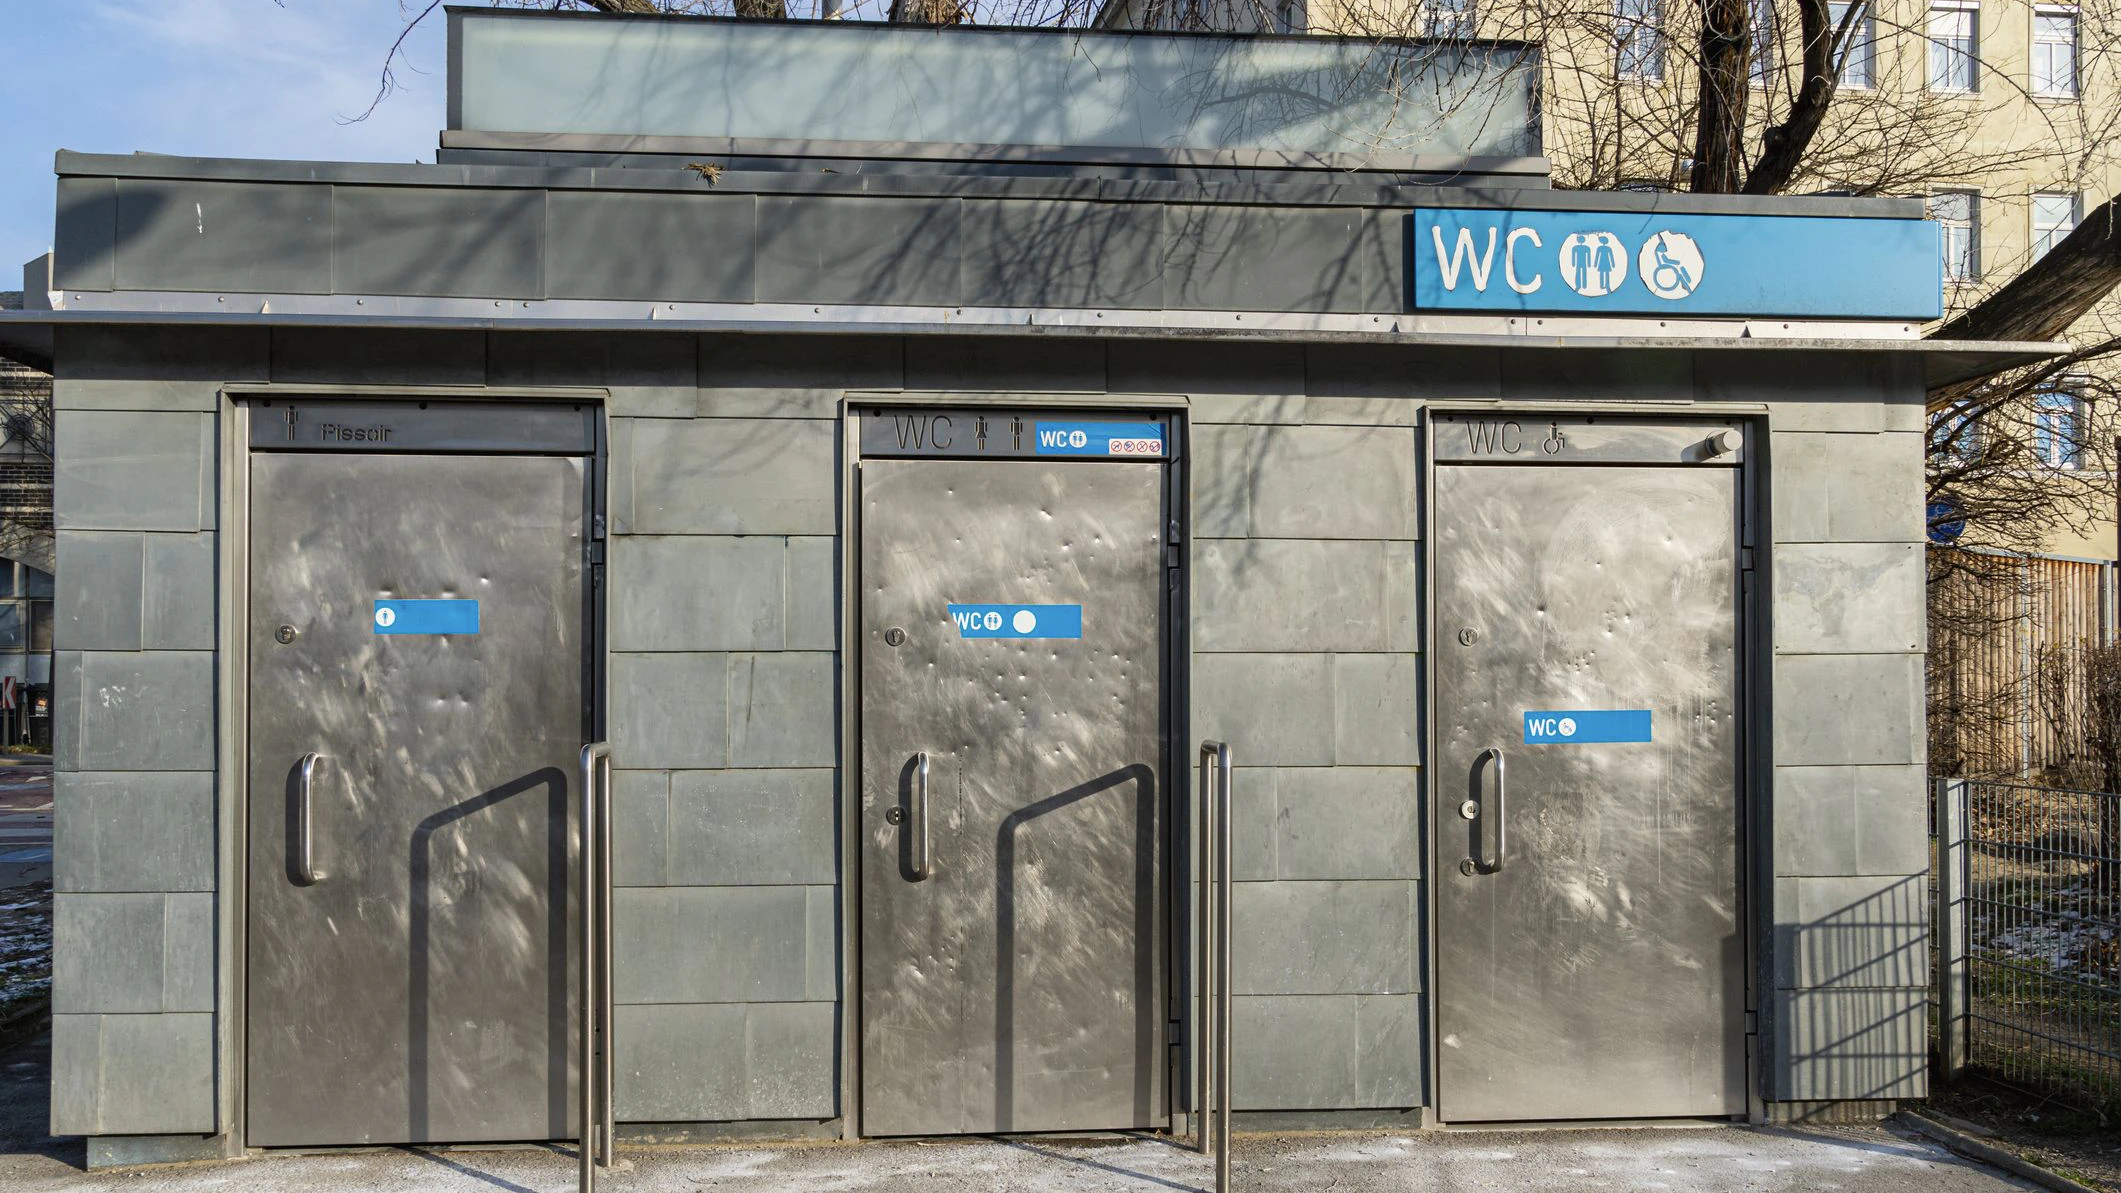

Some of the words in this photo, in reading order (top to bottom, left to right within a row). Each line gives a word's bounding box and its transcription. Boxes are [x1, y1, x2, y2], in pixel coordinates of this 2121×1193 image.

[1432, 225, 1542, 294] WC
[321, 423, 392, 442] Pissoir
[893, 414, 953, 449] WC
[1040, 430, 1067, 448] WC
[1466, 420, 1522, 454] WC
[952, 611, 982, 630] WC
[1528, 718, 1557, 737] WC
